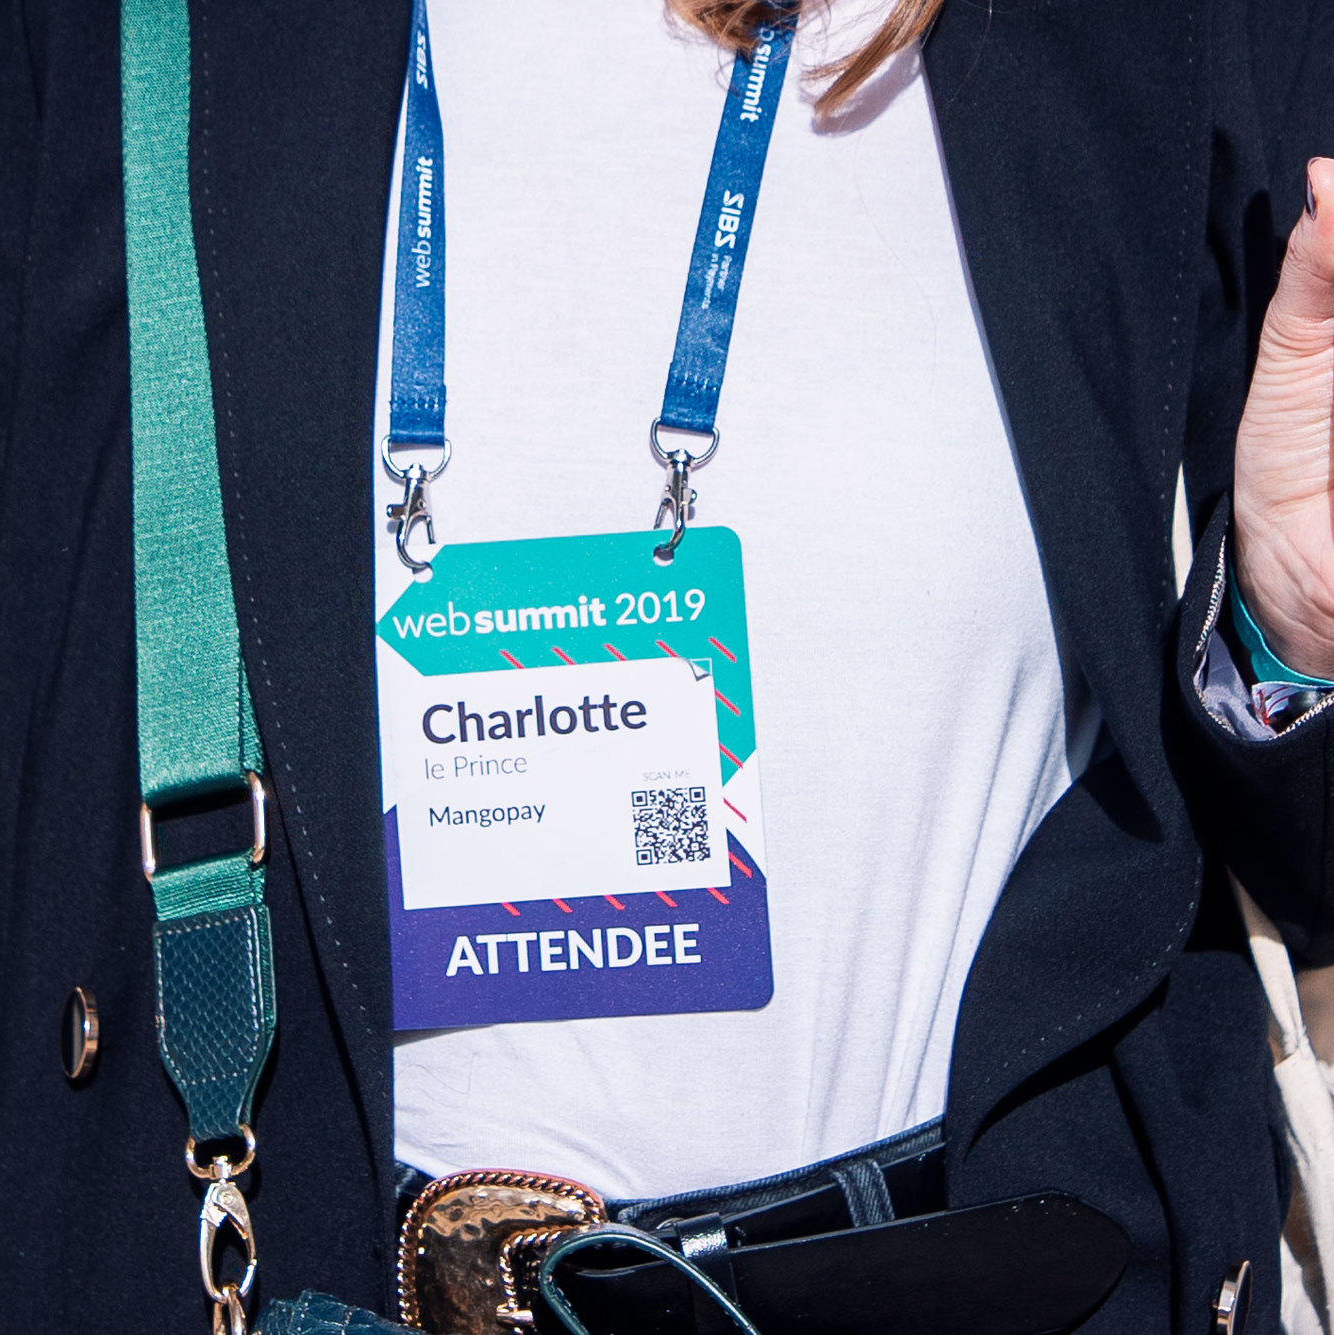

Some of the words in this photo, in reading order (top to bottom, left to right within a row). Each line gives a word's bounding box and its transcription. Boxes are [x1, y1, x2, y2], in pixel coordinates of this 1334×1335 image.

[714, 190, 745, 249] SIBS
[615, 588, 707, 626] 2019
[422, 694, 648, 745] Charlotte
[424, 758, 445, 780] le
[453, 755, 528, 778] Prince
[429, 804, 547, 828] Mangopay
[445, 923, 703, 977] ATTENDEE
